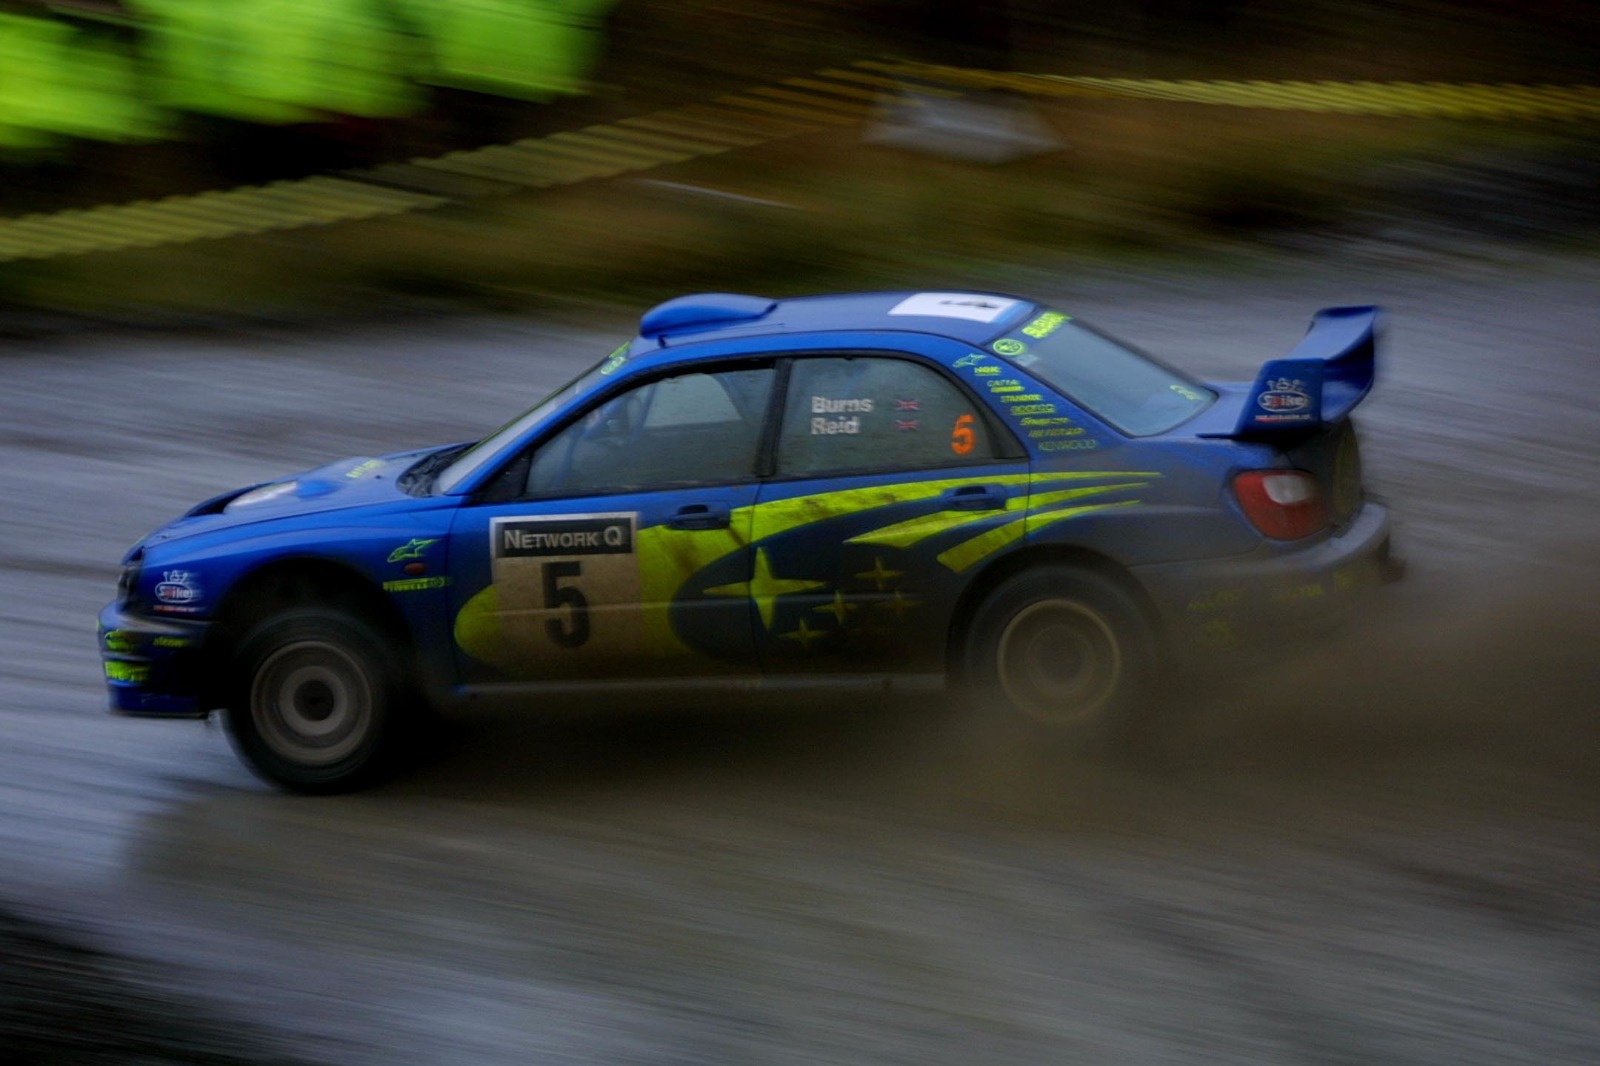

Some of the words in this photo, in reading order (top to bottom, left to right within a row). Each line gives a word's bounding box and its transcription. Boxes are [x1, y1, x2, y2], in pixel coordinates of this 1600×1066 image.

[811, 396, 874, 413] Burns
[811, 416, 861, 435] Reid
[951, 414, 976, 455] 5
[603, 526, 622, 546] Q
[543, 561, 591, 648] 5
